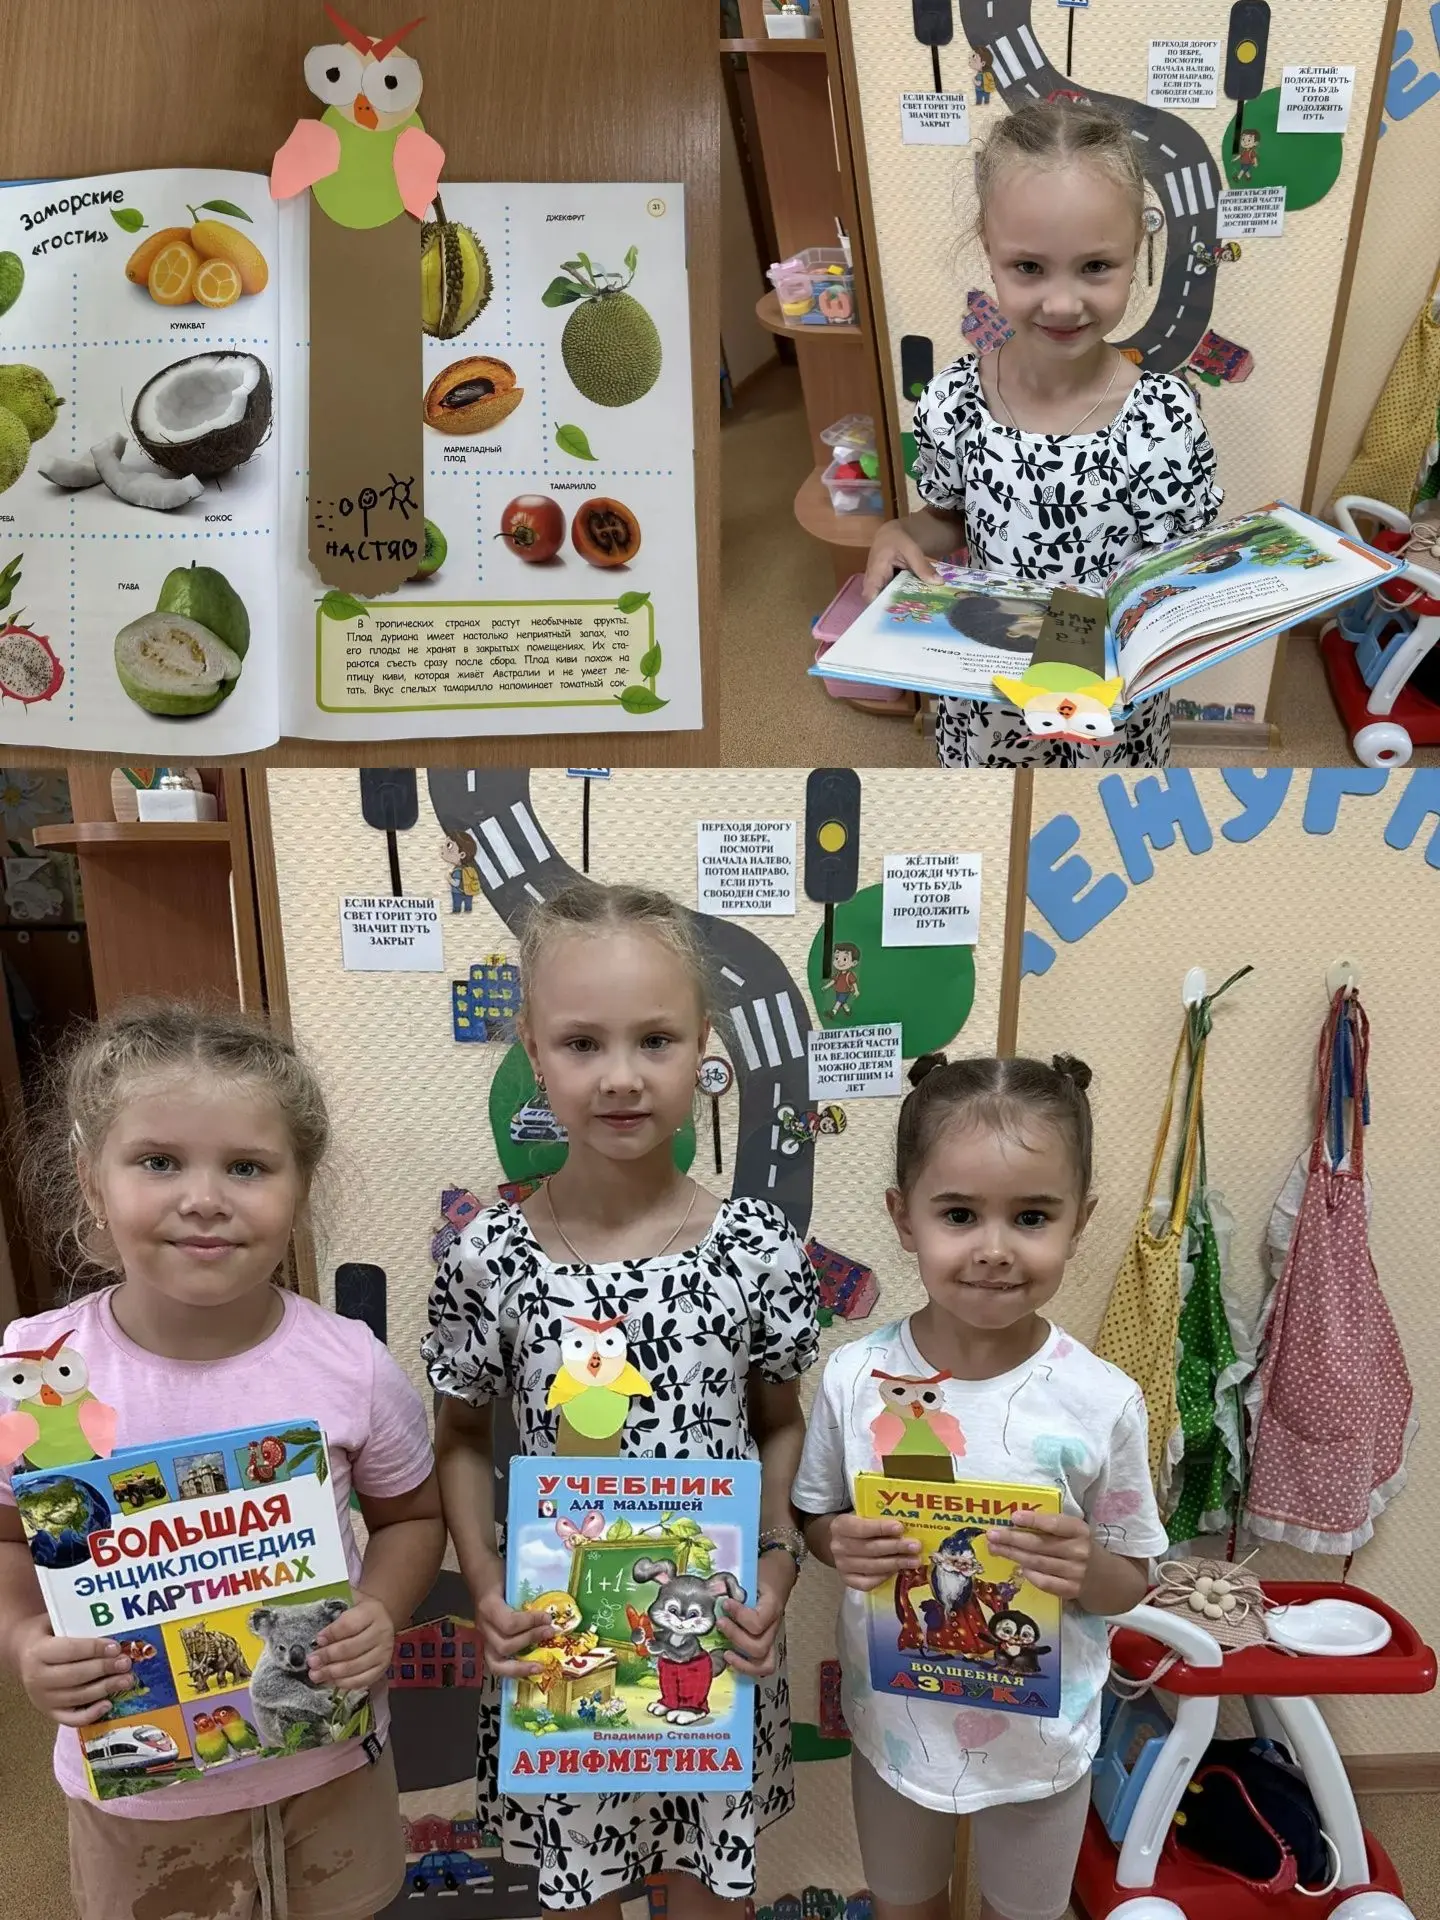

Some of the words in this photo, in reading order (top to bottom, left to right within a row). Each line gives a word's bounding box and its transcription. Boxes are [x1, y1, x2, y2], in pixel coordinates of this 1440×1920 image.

[20, 190, 124, 231] Заморские
[546, 214, 585, 222] ДЖЕКФРУТ
[32, 230, 109, 256] «гости»
[170, 322, 206, 330] КУМКВАТ
[444, 445, 502, 453] МАРМЕЛАДНЫЙ
[444, 455, 466, 463] ПЛОД
[550, 482, 597, 490] ТАМАРИЛЛО
[205, 514, 233, 522] КОКОС
[118, 582, 140, 591] ГУАВА
[357, 619, 364, 628] В
[376, 620, 434, 630] тропических
[445, 619, 480, 629] странах
[492, 619, 520, 629] растут
[531, 617, 583, 626] необычные
[594, 616, 629, 627] фрукты.
[346, 632, 372, 642] Плод
[381, 633, 419, 643] дуриана
[427, 633, 454, 641] имеет
[463, 631, 508, 640] настолько
[517, 629, 571, 641] неприятный
[580, 630, 606, 639] запах,
[346, 647, 362, 656] его
[369, 646, 400, 655] плоды
[408, 646, 419, 654] не
[426, 646, 456, 655] хранят
[476, 644, 519, 655] закрытых
[527, 643, 586, 652] помещениях.
[592, 641, 605, 650] Их
[612, 642, 629, 650] ста-
[346, 660, 379, 670] раются
[387, 659, 417, 668] съесть
[424, 659, 448, 669] сразу
[455, 658, 483, 666] после
[490, 656, 517, 667] сбора.
[524, 654, 549, 664] Плод
[556, 655, 578, 663] киви
[584, 654, 613, 663] похож
[619, 654, 630, 662] на
[346, 673, 374, 683] птицу
[382, 673, 406, 682] киви,
[414, 672, 450, 681] которая
[457, 669, 484, 679] живёт
[493, 669, 541, 680] Австралии
[548, 669, 555, 677] и
[581, 668, 607, 677] умеет
[614, 667, 629, 675] ле-
[346, 686, 367, 695] тать.
[373, 684, 394, 696] Вкус
[400, 685, 437, 694] спелых
[443, 682, 493, 692] тамарилло
[499, 681, 553, 690] напоминает
[560, 678, 603, 689] томатный
[609, 680, 627, 688] сок.
[702, 824, 751, 832] ПЕРЕХОДЯ
[724, 834, 737, 842] ПО
[906, 855, 959, 865] ЖЁЛТЫЙ!
[887, 869, 943, 879] ПОДОЖДИ
[946, 868, 978, 877] ЧУТЬ-
[903, 882, 931, 890] ЧУТЬ
[934, 881, 962, 890] БУДЬ
[704, 890, 753, 898] СВОБОДЕН
[914, 894, 950, 903] ГОТОВ
[345, 899, 375, 907] ЕСЛИ
[379, 898, 434, 908] КРАСНЫЙ
[344, 911, 372, 920] СВЕТ
[376, 912, 412, 920] ГОРИТ
[415, 912, 437, 921] ЭТО
[893, 906, 970, 916] ПРОДОЛЖИТЬ
[353, 924, 397, 932] ЗНАЧИТ
[400, 925, 430, 933] ПУТЬ
[917, 919, 945, 928] ПУТЬ
[370, 937, 415, 945] ЗАКРЫТ
[817, 1029, 874, 1040] ДВИГАТЬСЯ
[811, 1039, 863, 1051] ПРОЕЗЖЕЙ
[866, 1038, 898, 1047] ЧАСТИ
[831, 1049, 895, 1060] ВЕЛОСИПЕДЕ
[818, 1063, 856, 1072] МОЖНО
[858, 1061, 892, 1070] ДЕТЯМ
[817, 1073, 881, 1084] ДОСТИГШИМ
[846, 1084, 865, 1092] ЛЕТ
[537, 1475, 734, 1497] УЧЕБНИК
[569, 1498, 604, 1512] для
[613, 1497, 703, 1512] малышей
[880, 1508, 920, 1519] для
[932, 1511, 1015, 1528] малыш
[87, 1493, 292, 1568] БОЛЬШАЯ
[73, 1528, 317, 1597] ЭНЦИКЛОПЕДИЯ
[88, 1602, 115, 1627] В
[121, 1555, 316, 1620] КАРТИНКАХ
[911, 1662, 1025, 1687] ВОЛШЕБНАЯ
[890, 1671, 1050, 1708] АЗБУКА
[593, 1731, 663, 1741] Владимир
[667, 1730, 731, 1740] Степанов
[511, 1747, 744, 1775] АРИФМЕТИКА
